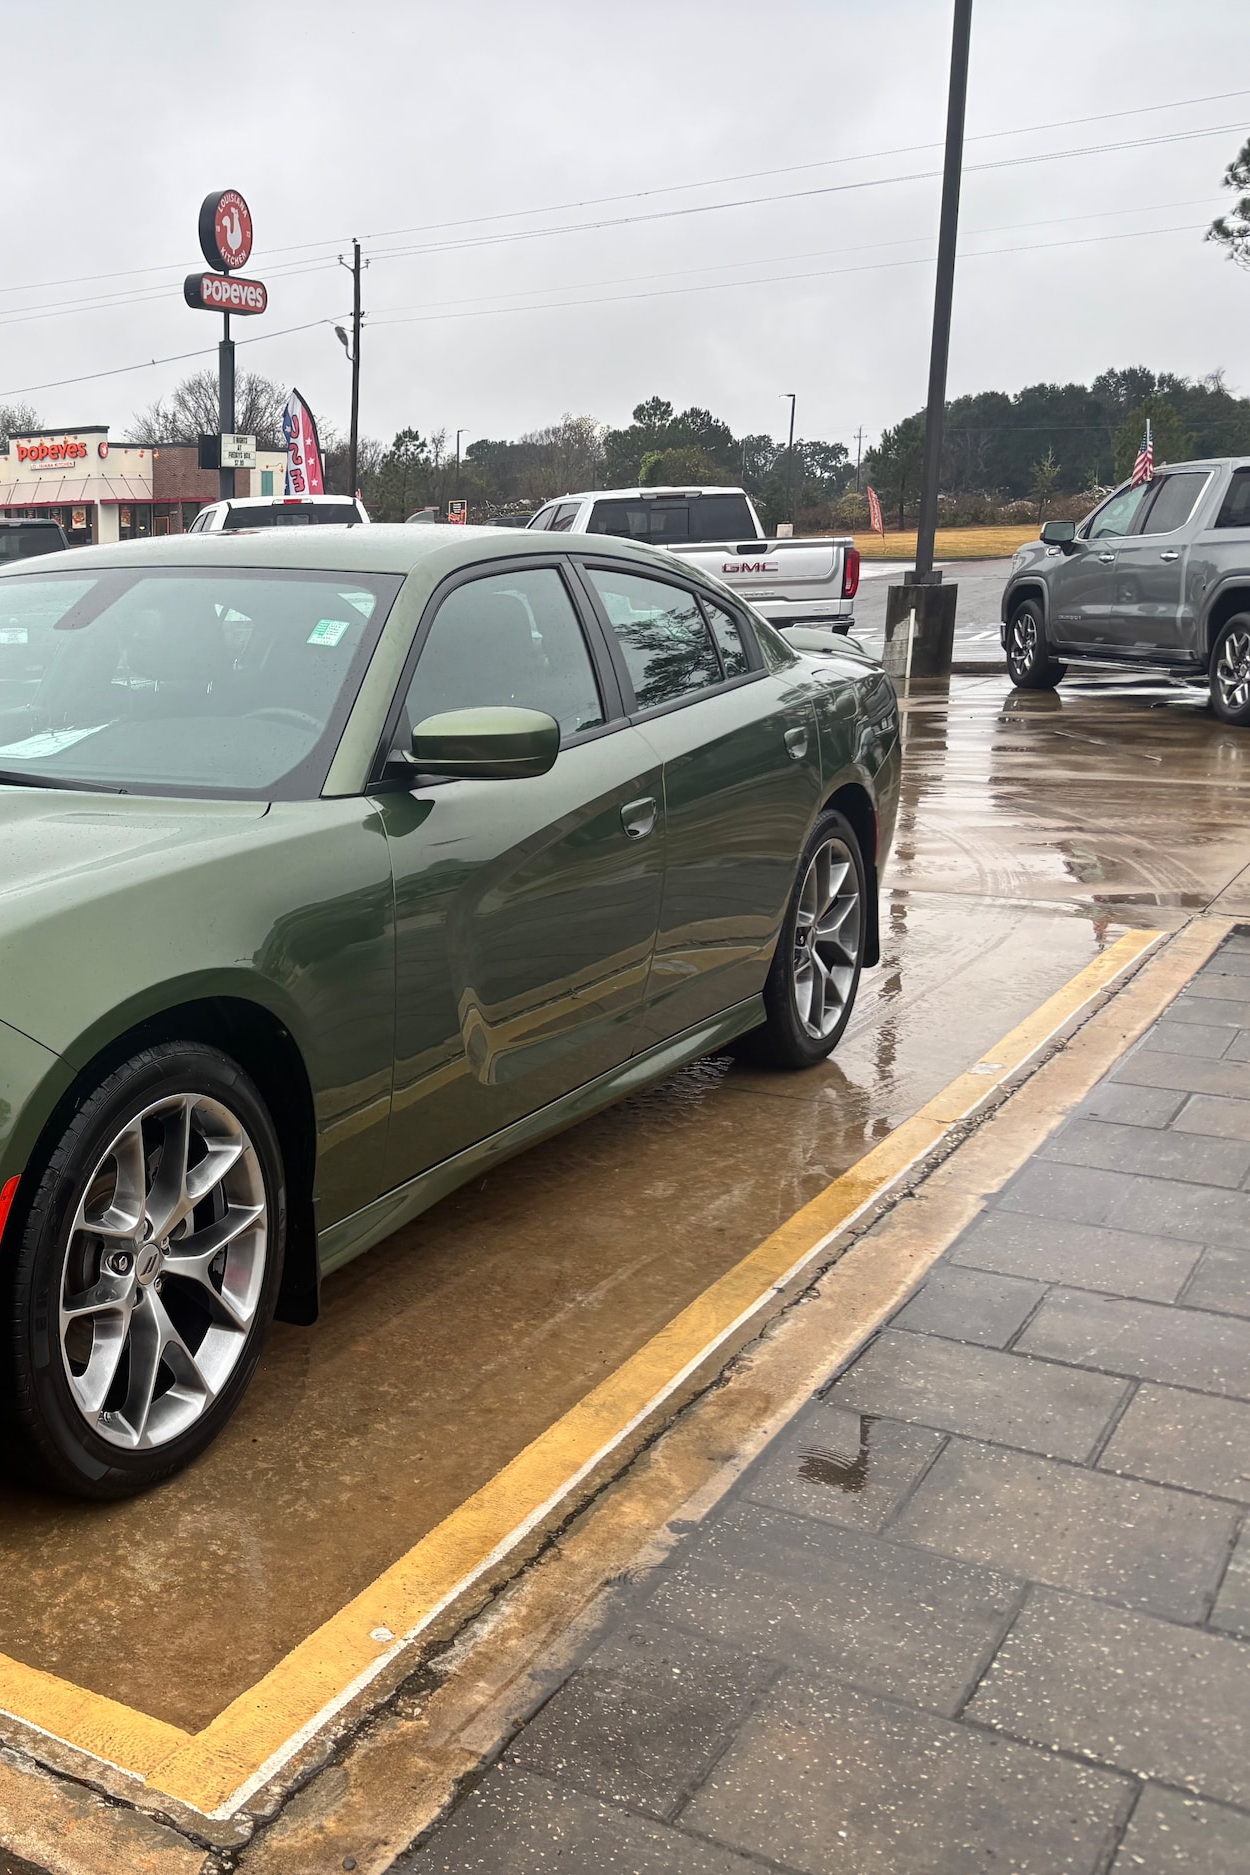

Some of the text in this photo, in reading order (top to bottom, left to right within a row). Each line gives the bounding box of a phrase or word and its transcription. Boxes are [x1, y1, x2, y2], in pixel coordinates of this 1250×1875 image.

[218, 193, 248, 218] LOUISIANA
[219, 247, 247, 266] KITCHEN
[722, 562, 778, 573] GMC
